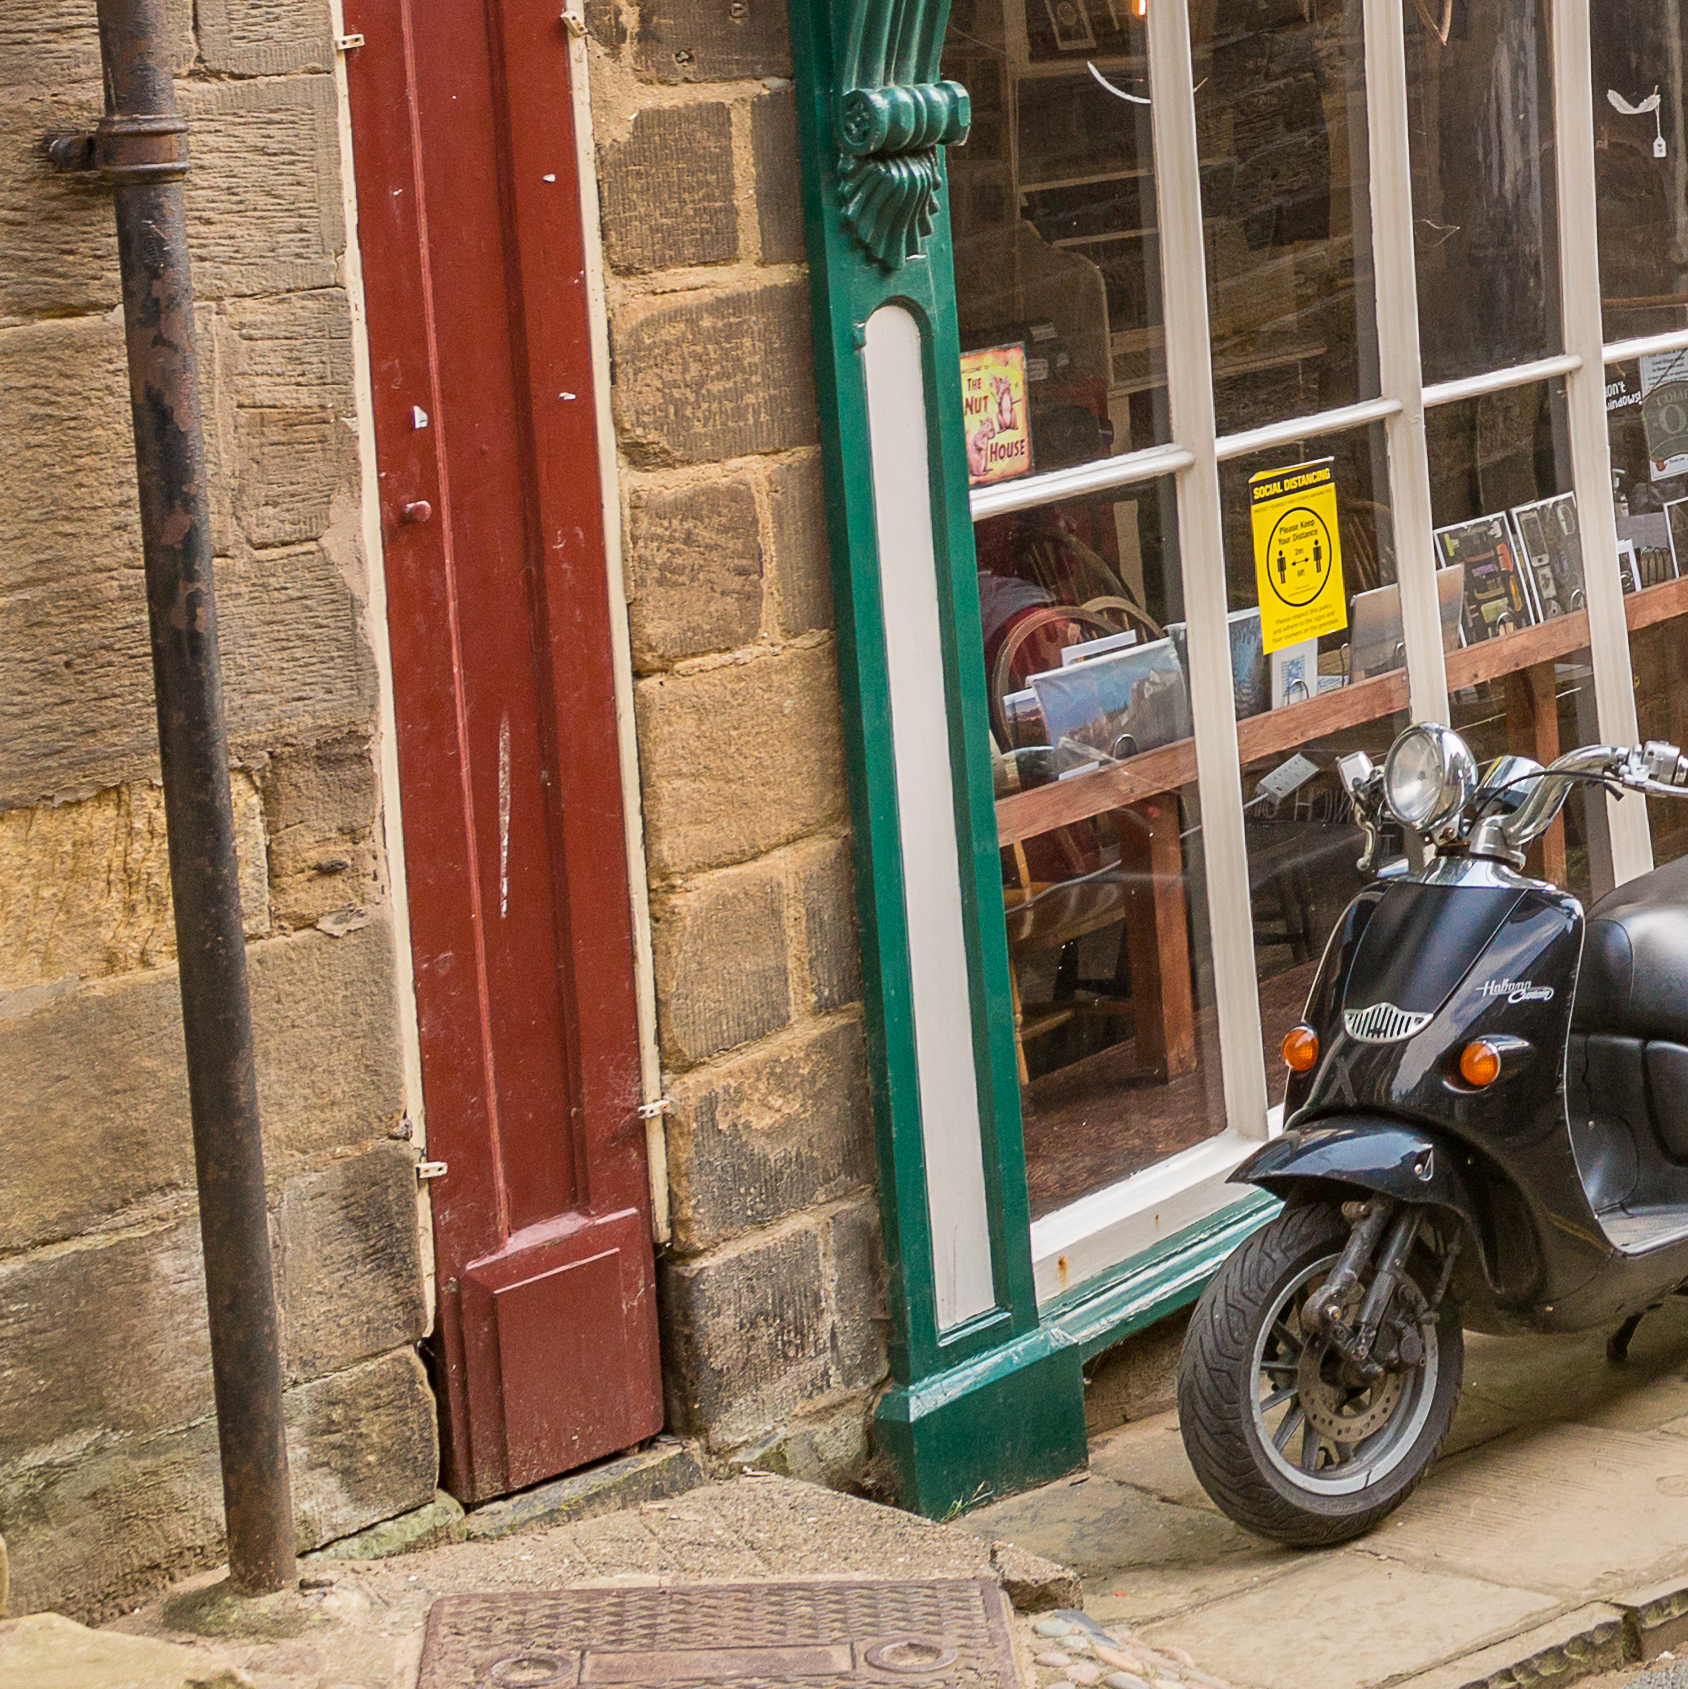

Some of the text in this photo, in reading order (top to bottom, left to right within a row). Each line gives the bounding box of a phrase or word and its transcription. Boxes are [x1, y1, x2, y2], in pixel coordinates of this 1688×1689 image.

[1253, 467, 1331, 500] SOCIAL DISTANCING
[1279, 519, 1315, 535] Please Keep
[1278, 529, 1318, 546] Your Distance
